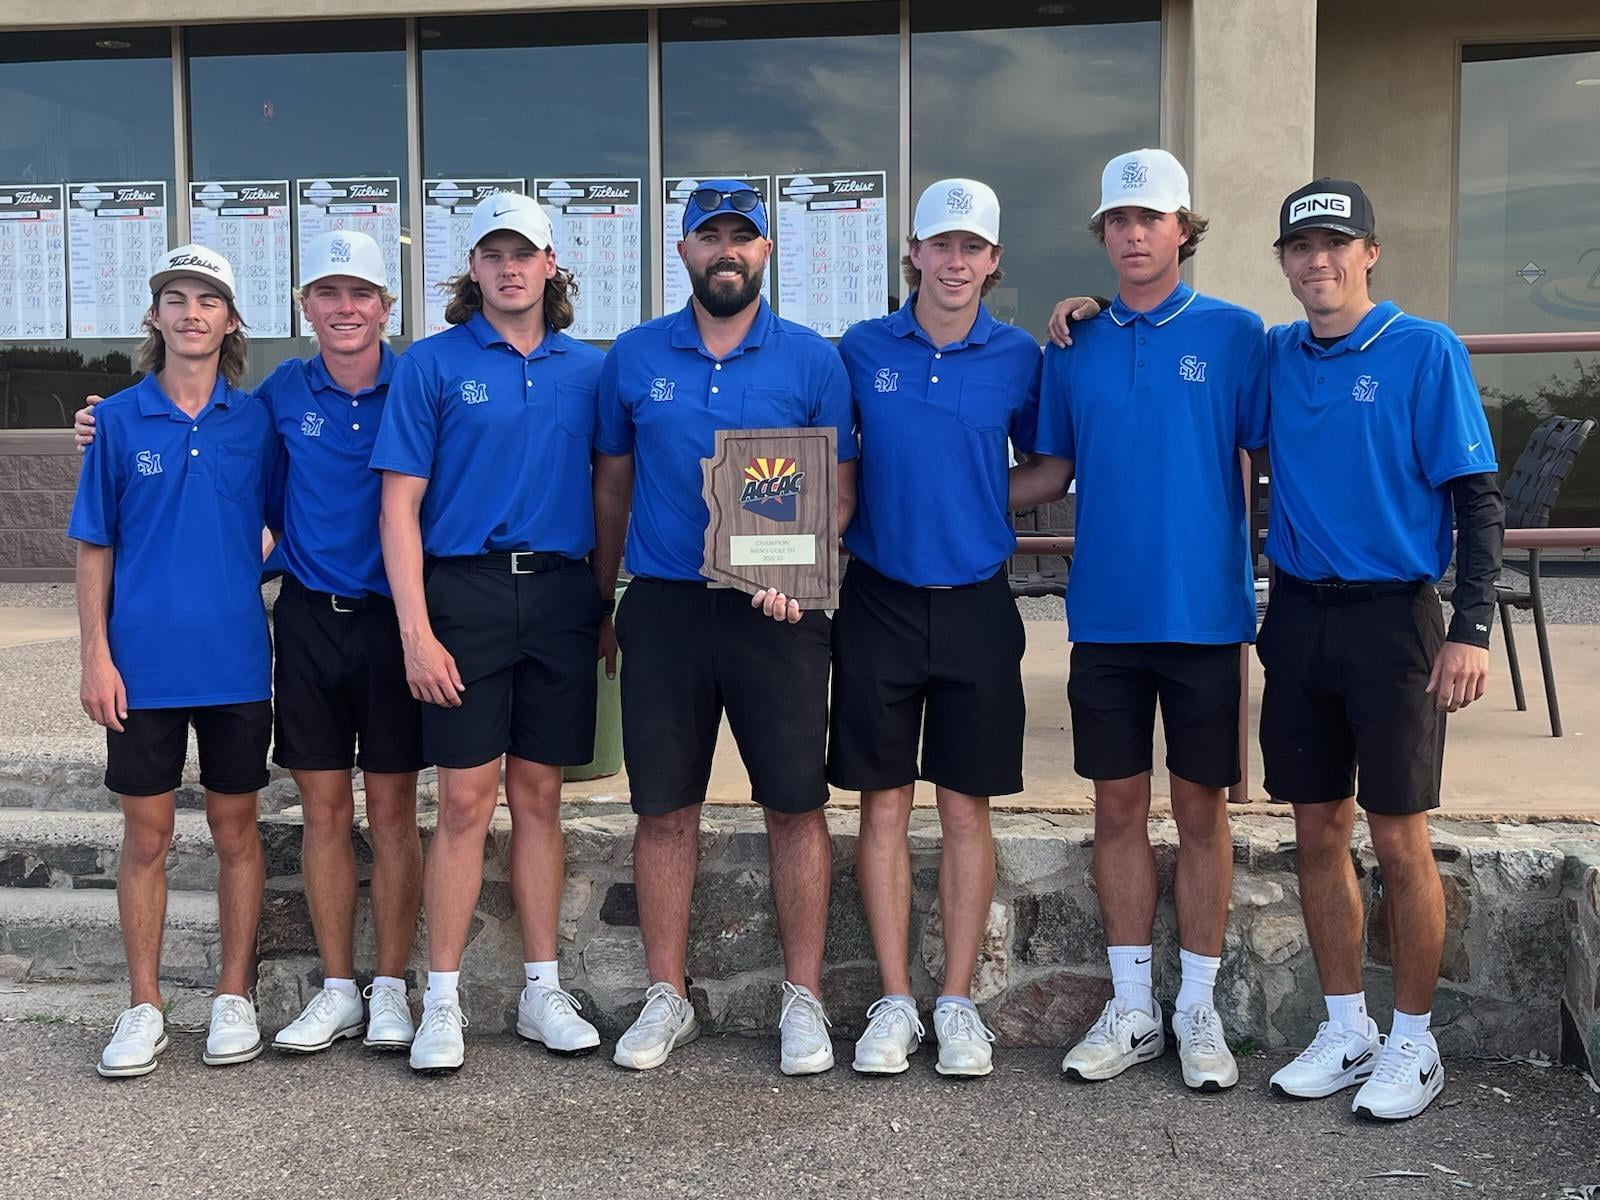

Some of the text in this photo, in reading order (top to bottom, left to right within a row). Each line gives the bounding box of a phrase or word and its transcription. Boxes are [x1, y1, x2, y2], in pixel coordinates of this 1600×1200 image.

[349, 184, 389, 199] Titleist
[588, 185, 630, 199] Titleist
[832, 179, 875, 195] Titleist
[14, 191, 53, 205] Titleist
[115, 189, 156, 203] Titleist
[239, 187, 280, 201] Titleist
[1294, 198, 1345, 218] PING
[100, 223, 114, 234] 74
[126, 222, 141, 233] 77
[451, 220, 470, 232] 80
[567, 220, 582, 233] 74
[597, 220, 615, 233] 73
[810, 215, 827, 229] 75
[838, 214, 856, 227] 70
[46, 224, 62, 237] 140
[221, 222, 238, 235] 75
[100, 237, 114, 249] 77
[843, 230, 857, 243] 71
[568, 251, 583, 262] 70
[599, 250, 615, 262] 70
[812, 247, 828, 258] 68
[842, 246, 859, 258] 70
[169, 254, 223, 273] Titleist
[25, 282, 41, 294] 85
[128, 280, 143, 291] 77
[843, 275, 858, 288] 71
[27, 296, 40, 308] 71
[598, 295, 612, 307] 78
[622, 295, 637, 306] 161
[812, 292, 828, 304] 70
[844, 291, 857, 304] 71
[740, 472, 805, 503] ACCAC
